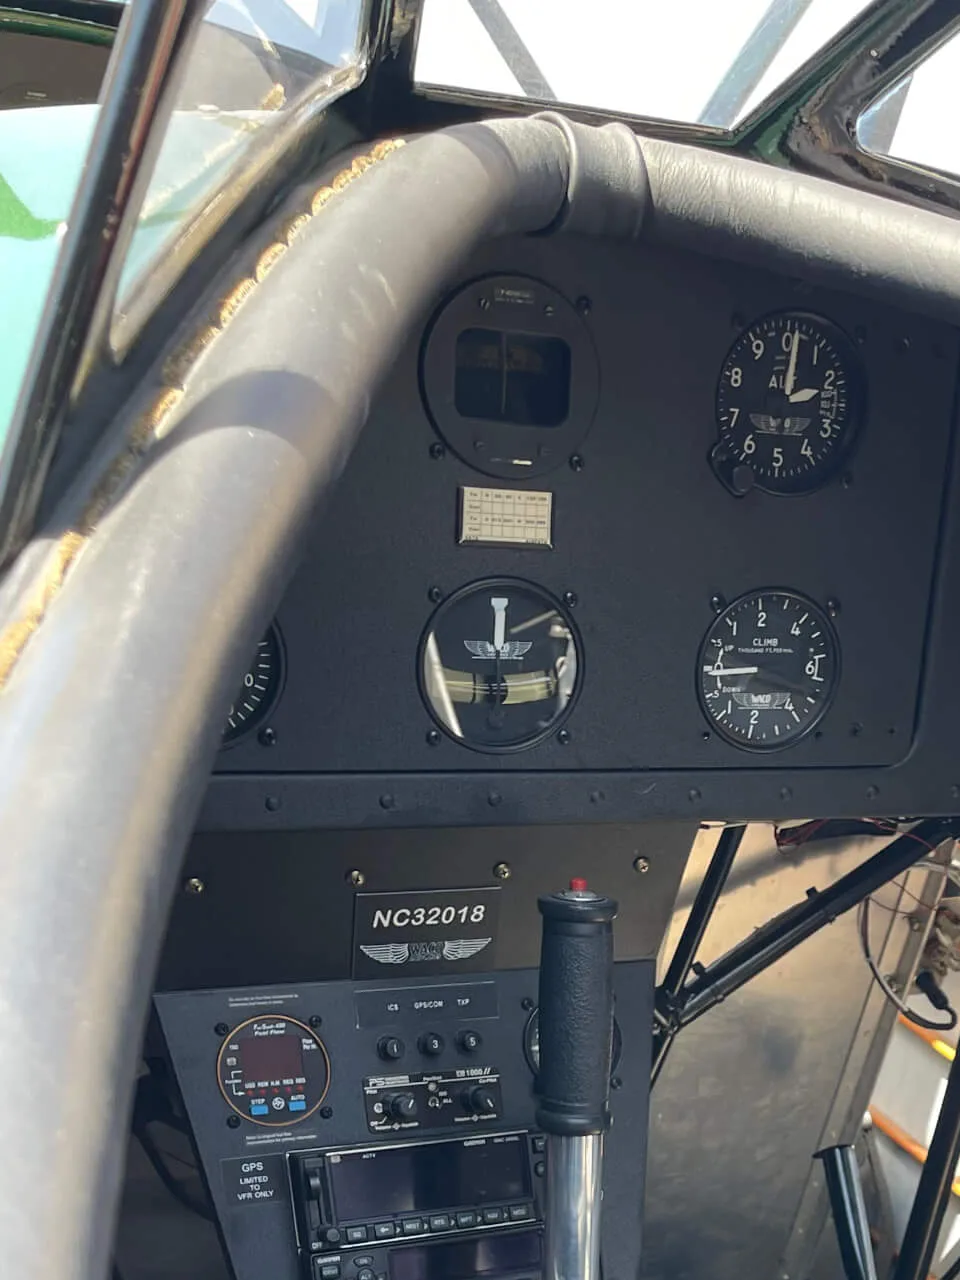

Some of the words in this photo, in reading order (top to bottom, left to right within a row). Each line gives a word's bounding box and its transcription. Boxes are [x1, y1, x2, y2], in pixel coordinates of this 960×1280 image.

[782, 332, 793, 352] 0
[752, 340, 764, 360] 9
[813, 345, 818, 366] 1
[730, 367, 742, 387] 8
[824, 370, 835, 389] 2
[729, 408, 739, 427] 7
[819, 419, 831, 437] 3
[743, 434, 755, 454] 6
[800, 438, 813, 456] 4
[772, 448, 783, 466] 5
[757, 612, 766, 627] 2
[732, 621, 737, 636] 1
[790, 622, 801, 636] 4
[752, 638, 778, 647] CLIMB
[805, 660, 814, 675] 6
[784, 698, 795, 710] 4
[750, 710, 759, 724] 2
[372, 904, 486, 929] NC32018
[432, 1039, 439, 1049] 3
[470, 1037, 476, 1047] 5
[241, 1162, 264, 1172] GPS
[240, 1175, 268, 1185] LIMITED
[237, 1192, 252, 1200] VFR
[254, 1190, 274, 1198] ONLY
